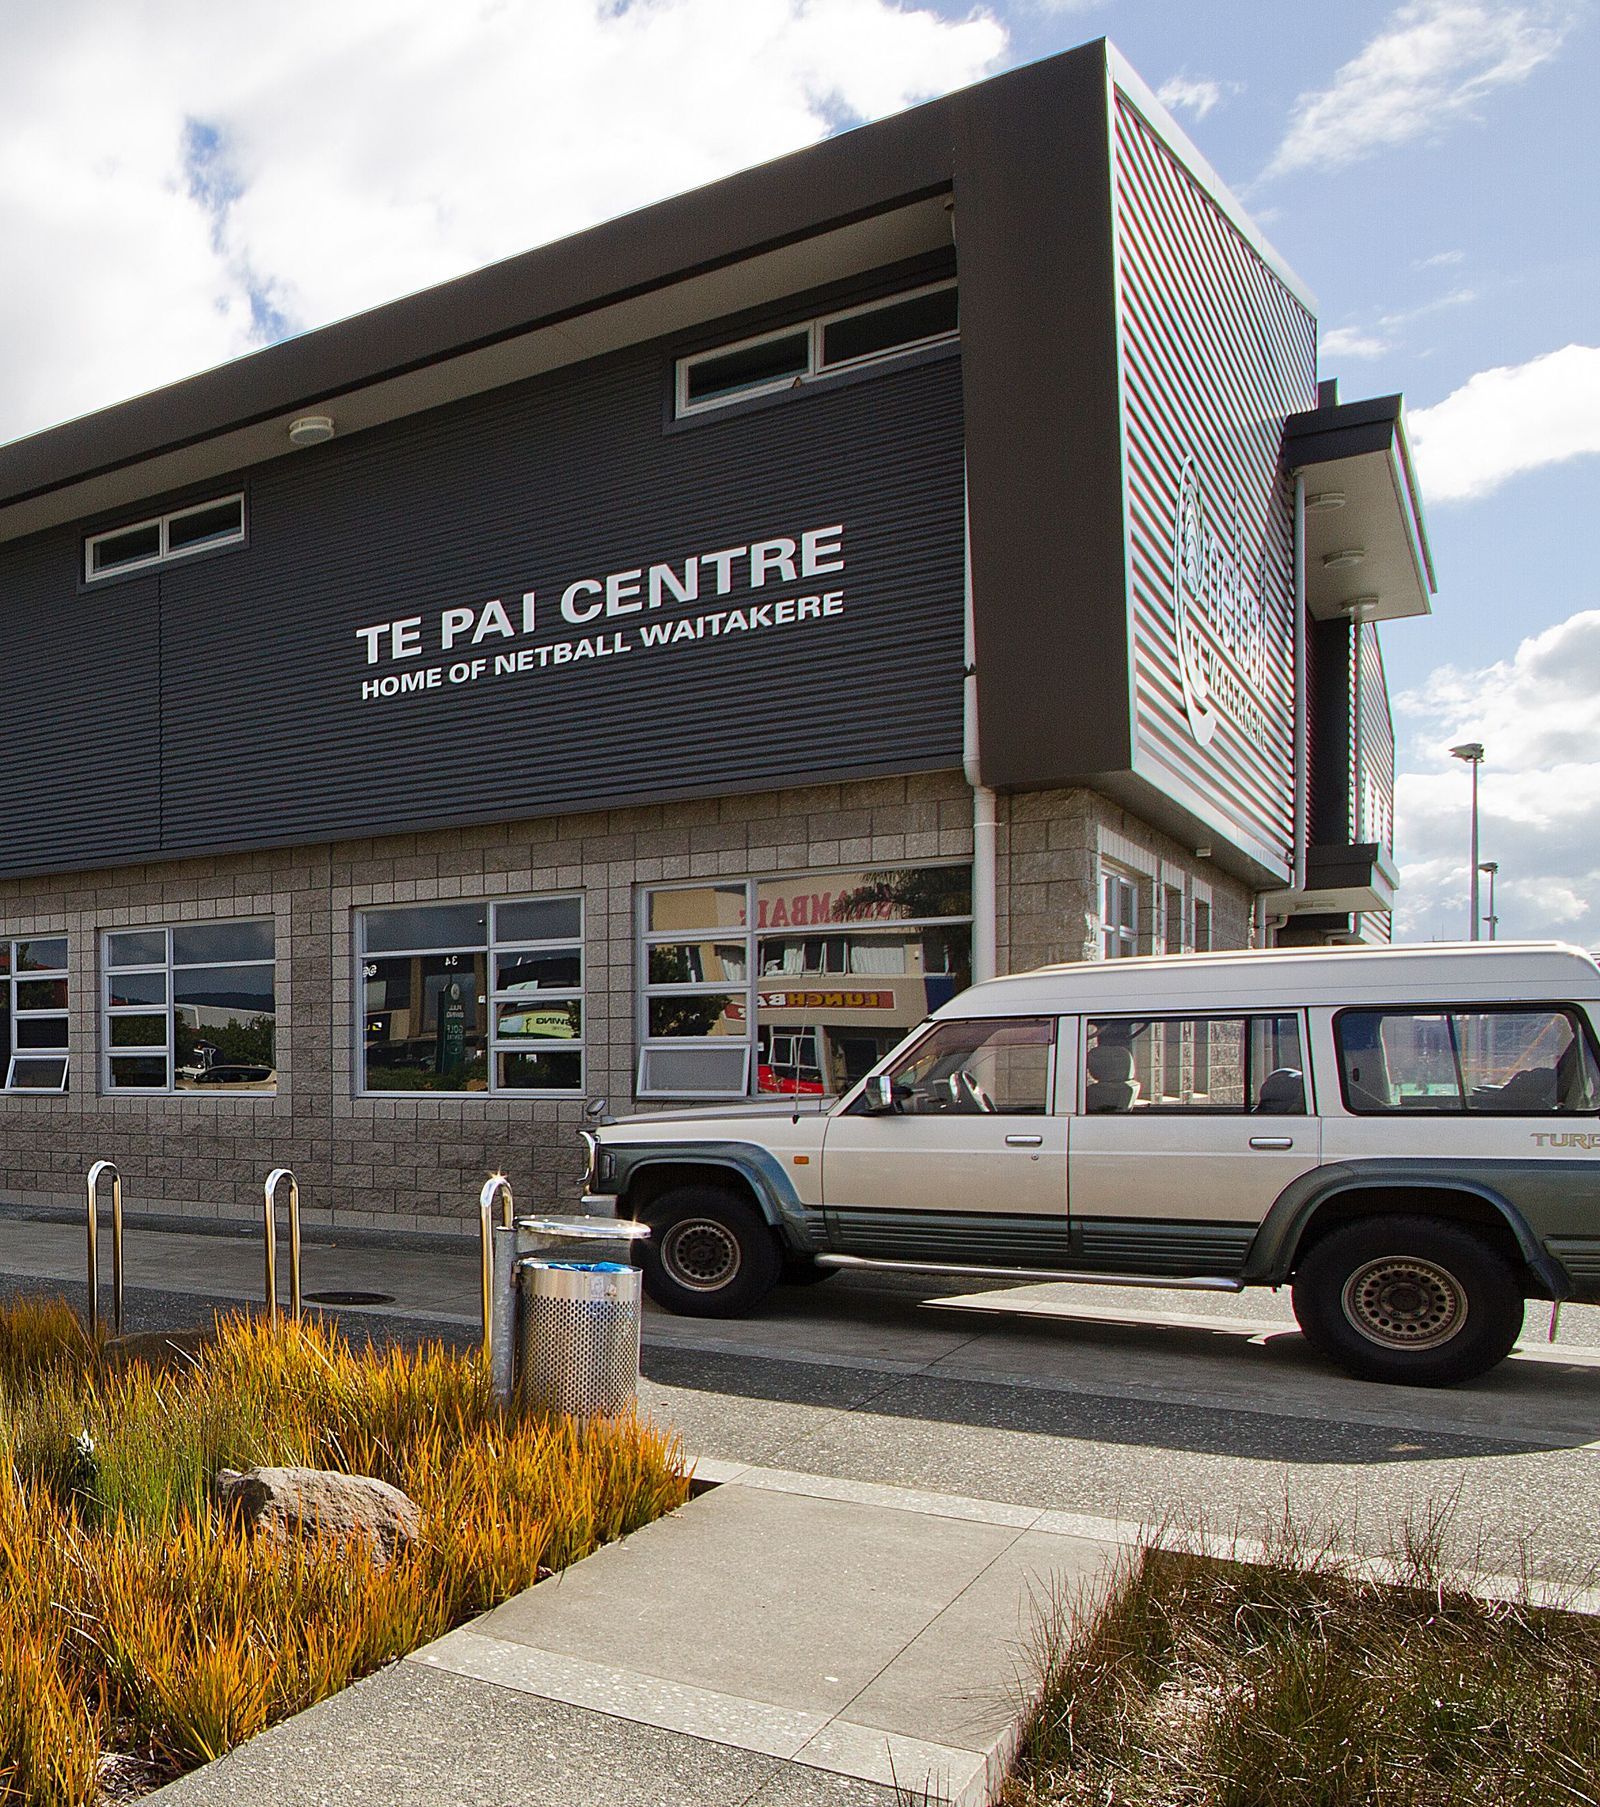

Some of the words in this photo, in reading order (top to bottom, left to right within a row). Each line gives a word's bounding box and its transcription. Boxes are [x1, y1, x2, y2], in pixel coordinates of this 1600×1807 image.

[356, 617, 422, 664] TE
[441, 592, 536, 649] PAI
[560, 524, 845, 624] CENTRE
[362, 666, 442, 700] HOME
[449, 658, 487, 684] OF
[494, 631, 631, 676] NETBALL
[639, 591, 845, 648] WAITAKERE
